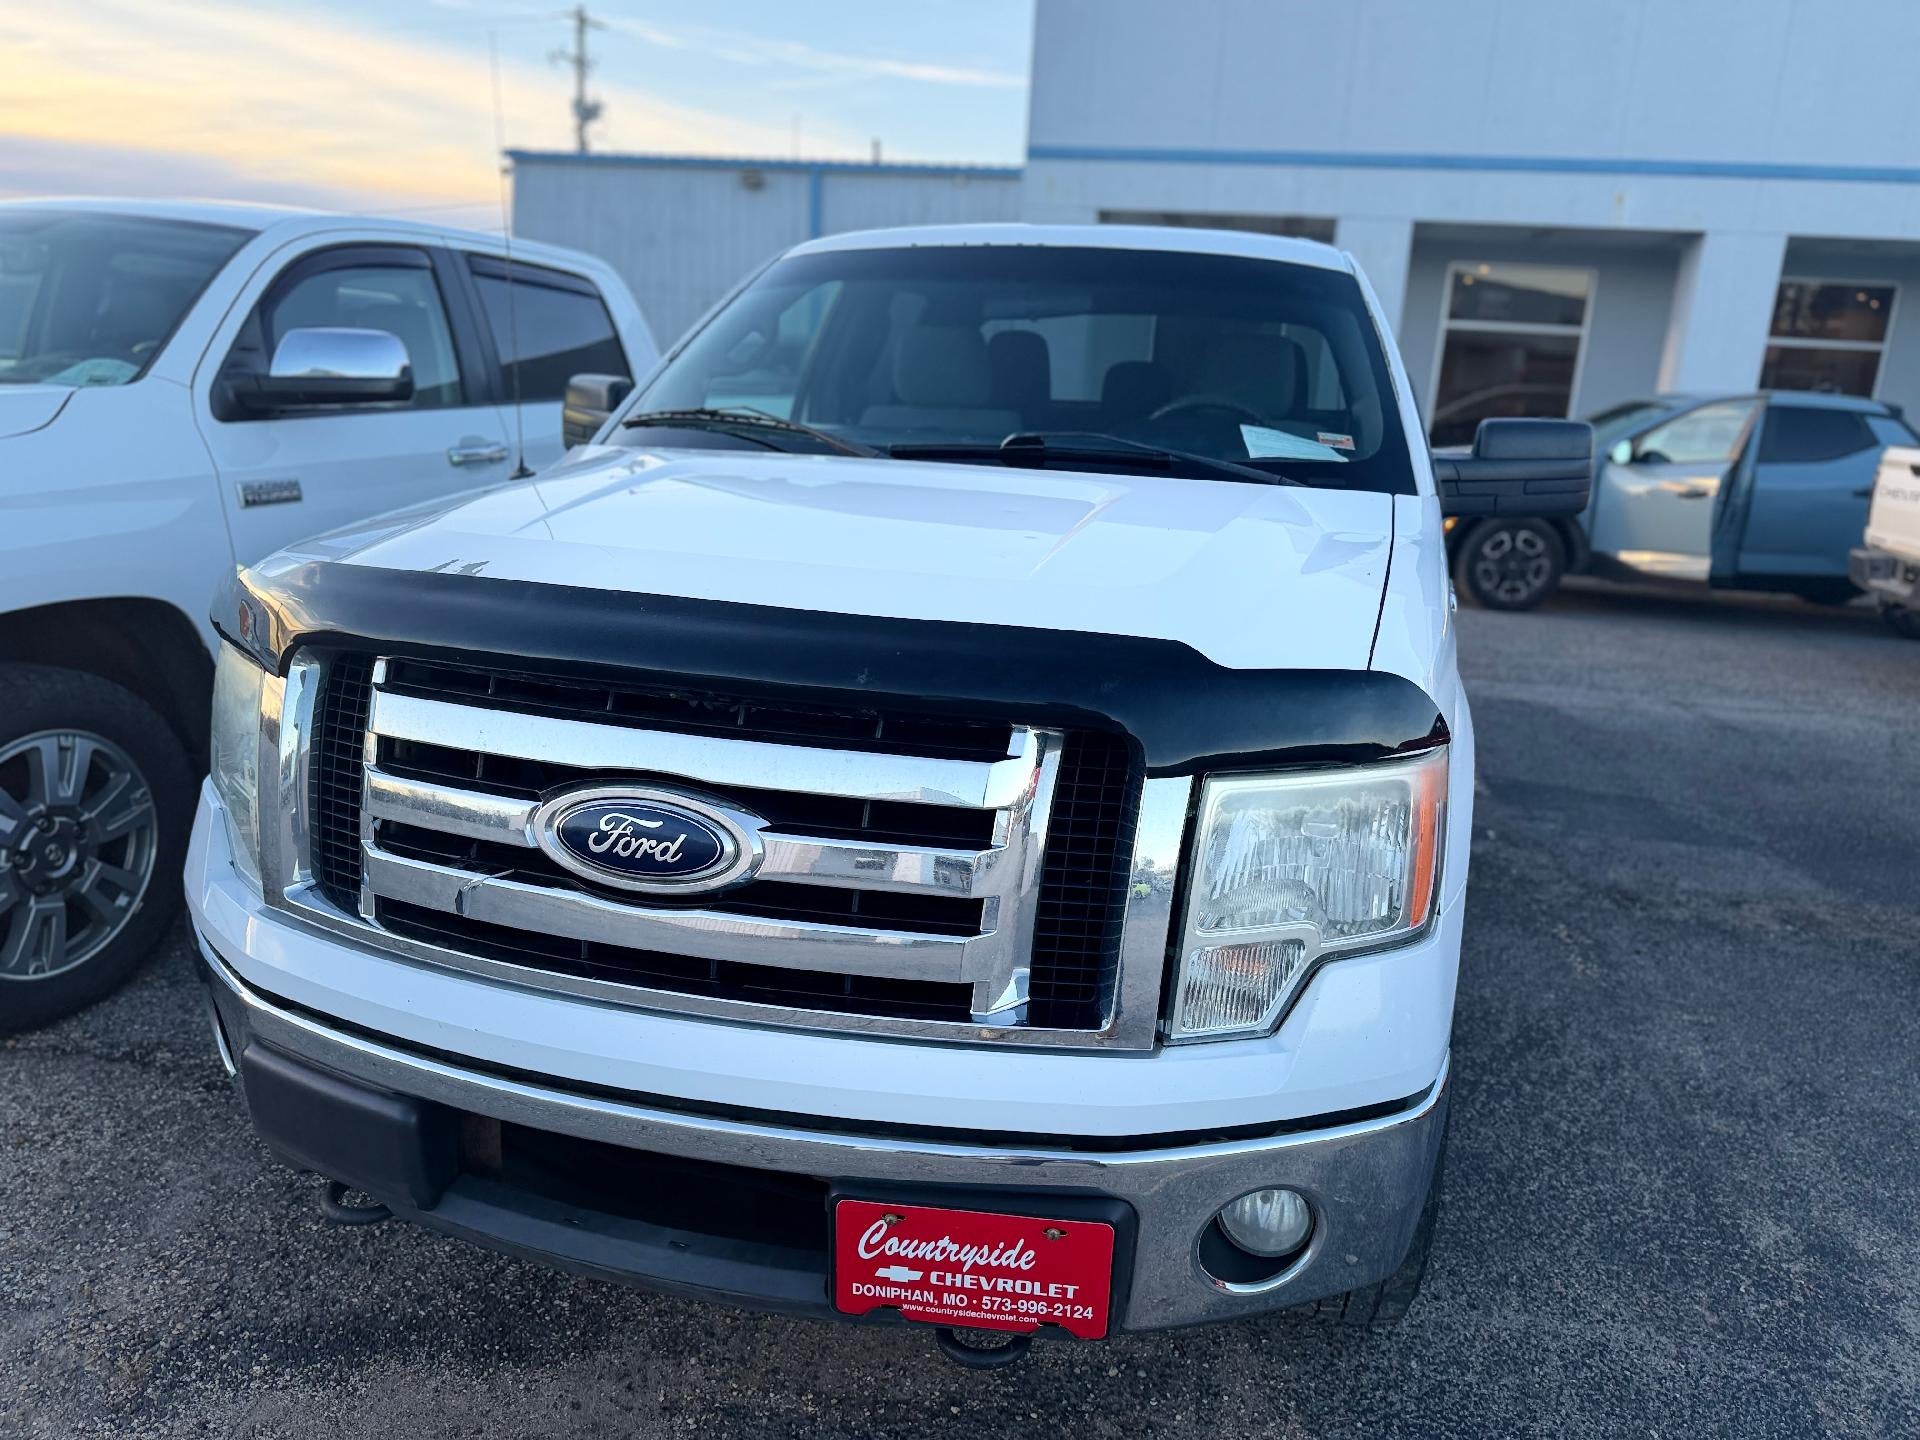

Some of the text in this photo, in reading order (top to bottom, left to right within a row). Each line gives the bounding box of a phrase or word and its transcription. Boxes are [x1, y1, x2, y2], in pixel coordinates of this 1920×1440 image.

[588, 813, 687, 863] Ford
[858, 1219, 1036, 1272] Countryside
[852, 1282, 1093, 1319] DONIPHAN, MO 573-996-2124
[930, 1271, 1079, 1299] CHEVROLET
[902, 1303, 1038, 1323] www.countrysidechevrolet.com
